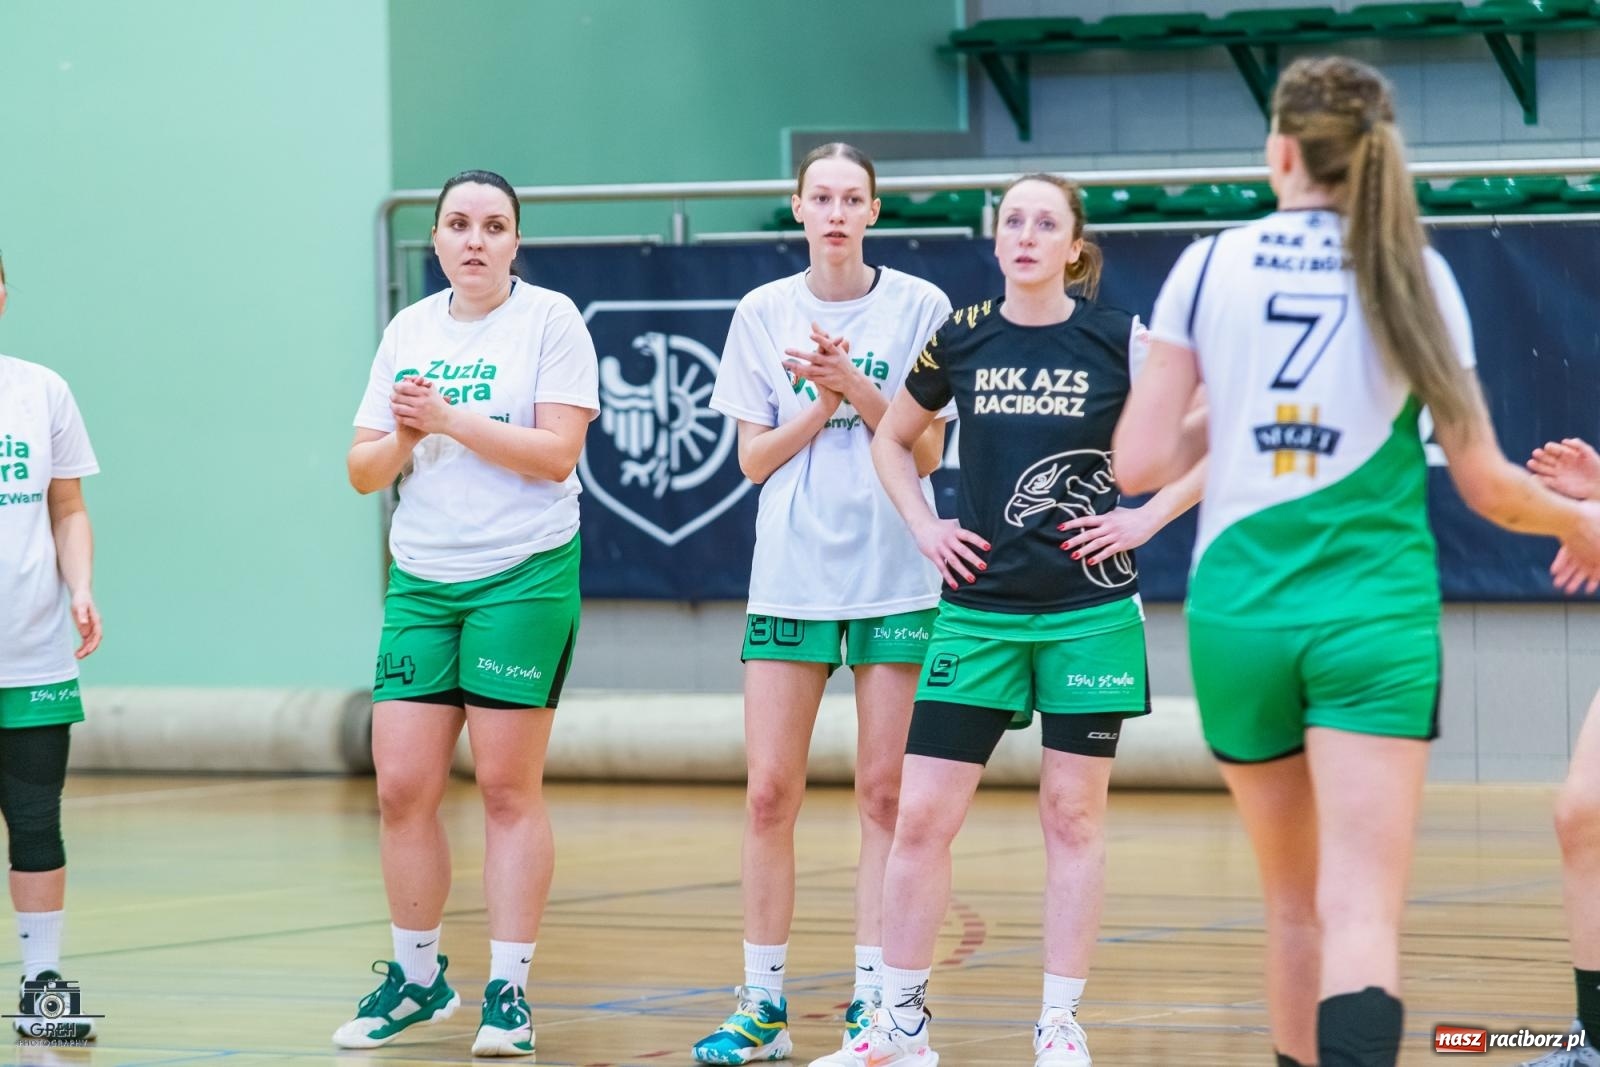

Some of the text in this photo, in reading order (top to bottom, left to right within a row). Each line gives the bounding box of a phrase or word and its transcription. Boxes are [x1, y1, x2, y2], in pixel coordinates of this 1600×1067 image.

[1266, 292, 1349, 390] 7
[424, 358, 497, 380] Zuzia
[974, 367, 1089, 394] RKK AZS
[439, 382, 491, 406] era
[974, 391, 1086, 417] RACIBÓRZ
[750, 615, 804, 646] 30
[374, 653, 415, 689] 24
[927, 652, 960, 687] 9
